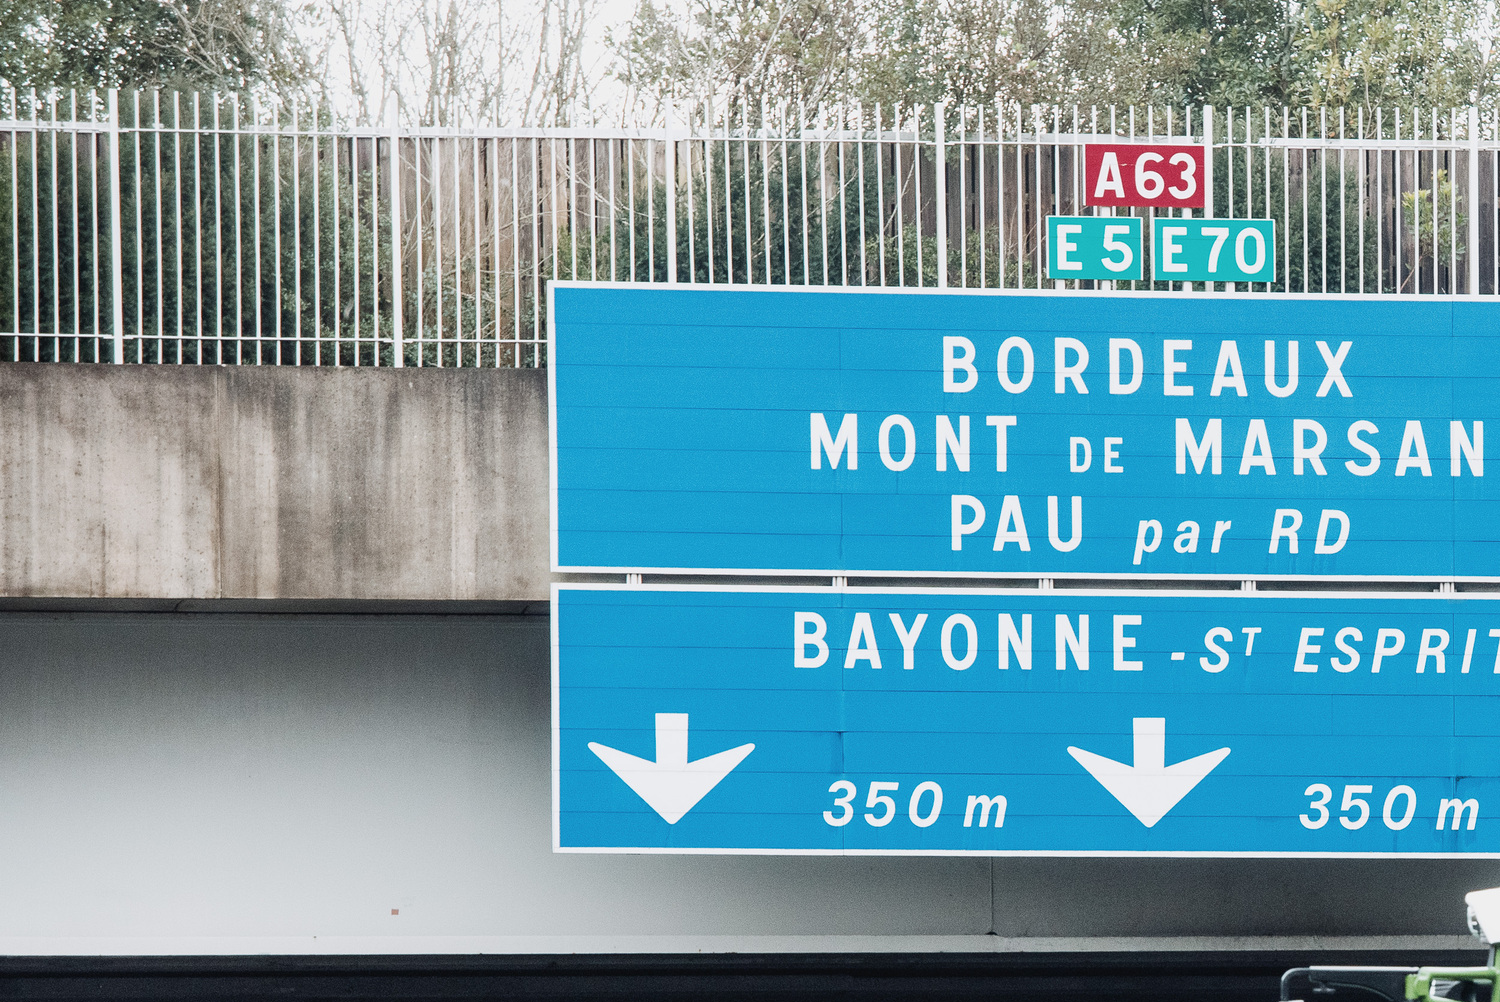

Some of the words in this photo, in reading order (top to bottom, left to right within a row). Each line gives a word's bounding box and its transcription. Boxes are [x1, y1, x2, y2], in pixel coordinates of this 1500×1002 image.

[943, 336, 1353, 397] BORDEAUX
[810, 413, 1017, 472] MONT
[1070, 437, 1123, 473] DE
[1176, 418, 1483, 476] MARSAN
[952, 495, 1082, 552] PAU
[1133, 520, 1231, 565] par
[1269, 509, 1350, 554] RD
[794, 612, 1143, 671] BAYONNE
[823, 780, 943, 827] 350
[964, 795, 1007, 827] m
[1299, 784, 1416, 830] 350
[1436, 799, 1479, 830] m
